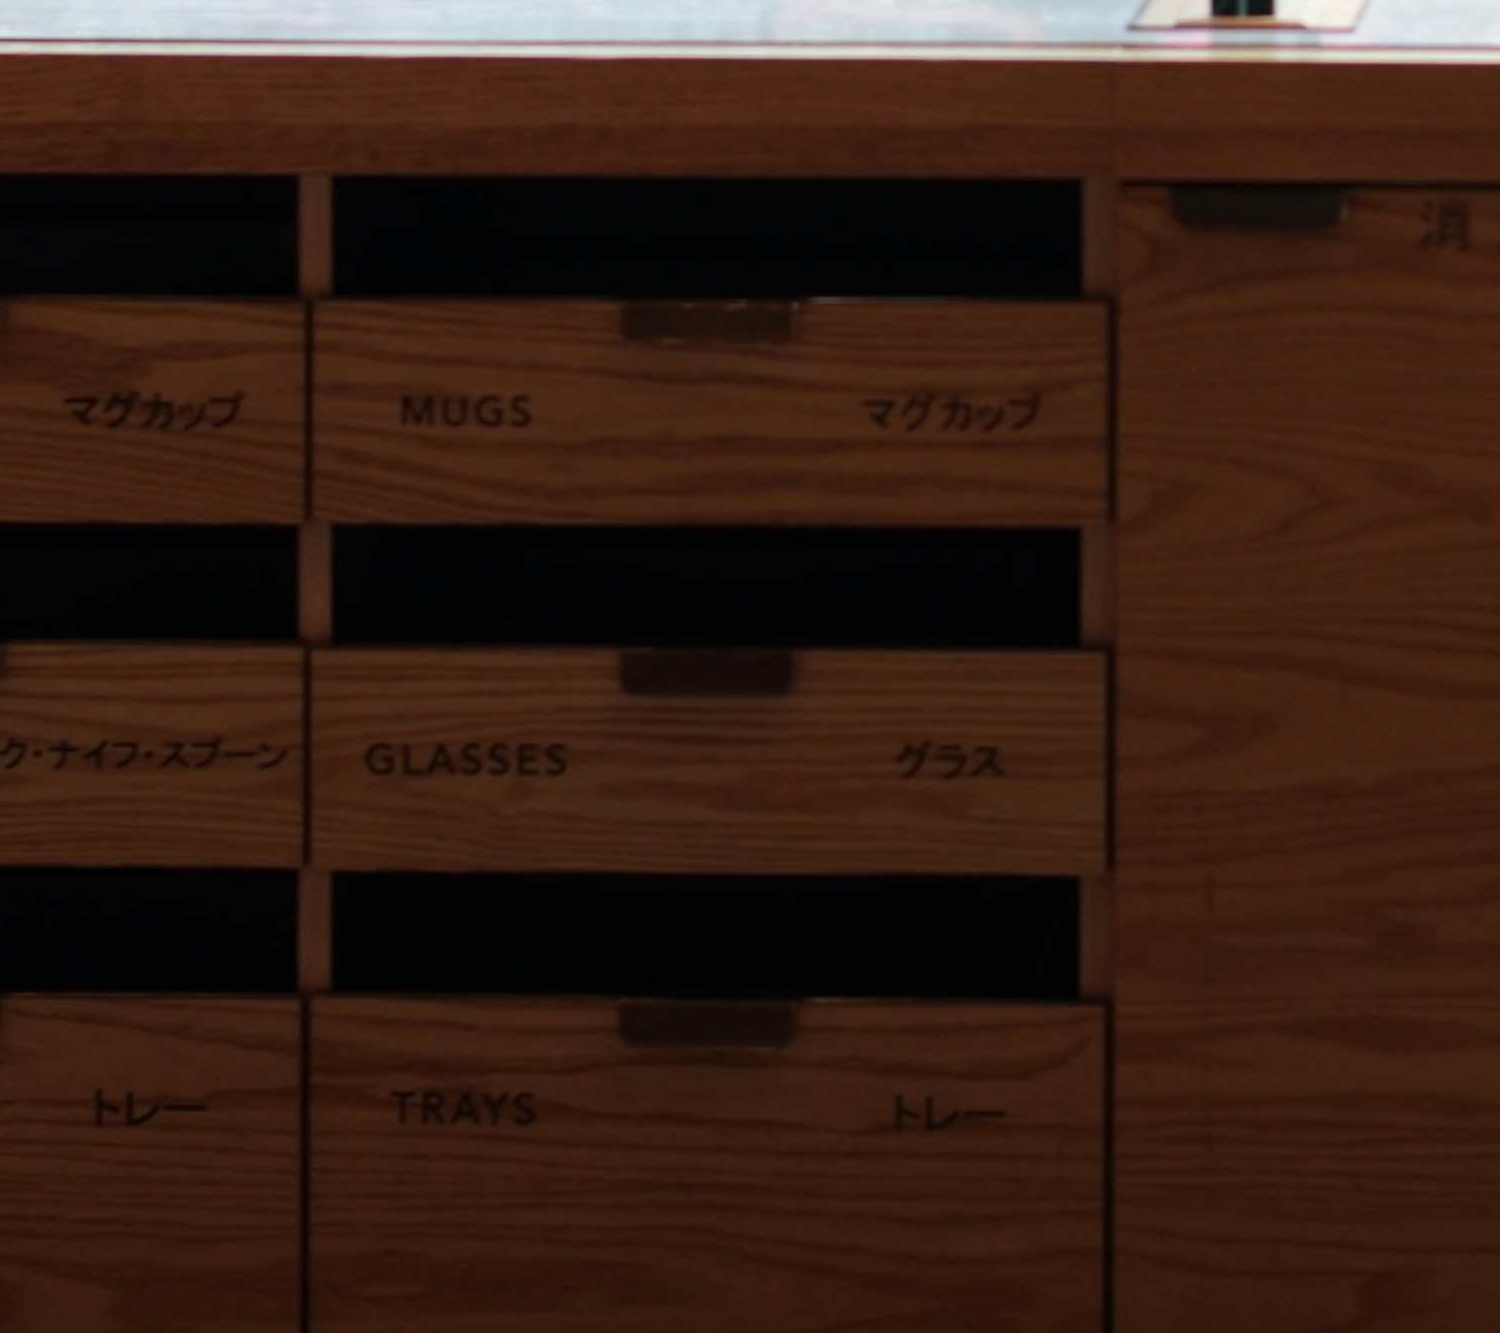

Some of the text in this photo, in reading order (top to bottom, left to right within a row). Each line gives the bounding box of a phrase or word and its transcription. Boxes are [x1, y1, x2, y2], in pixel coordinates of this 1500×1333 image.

[63, 389, 246, 432] マグカップ
[397, 394, 533, 429] MUGS
[859, 392, 1045, 434] マグカップ
[364, 742, 570, 778] GLASSES
[894, 739, 1008, 782] グラス
[92, 1085, 209, 1128] トレー
[390, 1092, 539, 1127] TRAYS
[893, 1094, 1008, 1133] トレー
